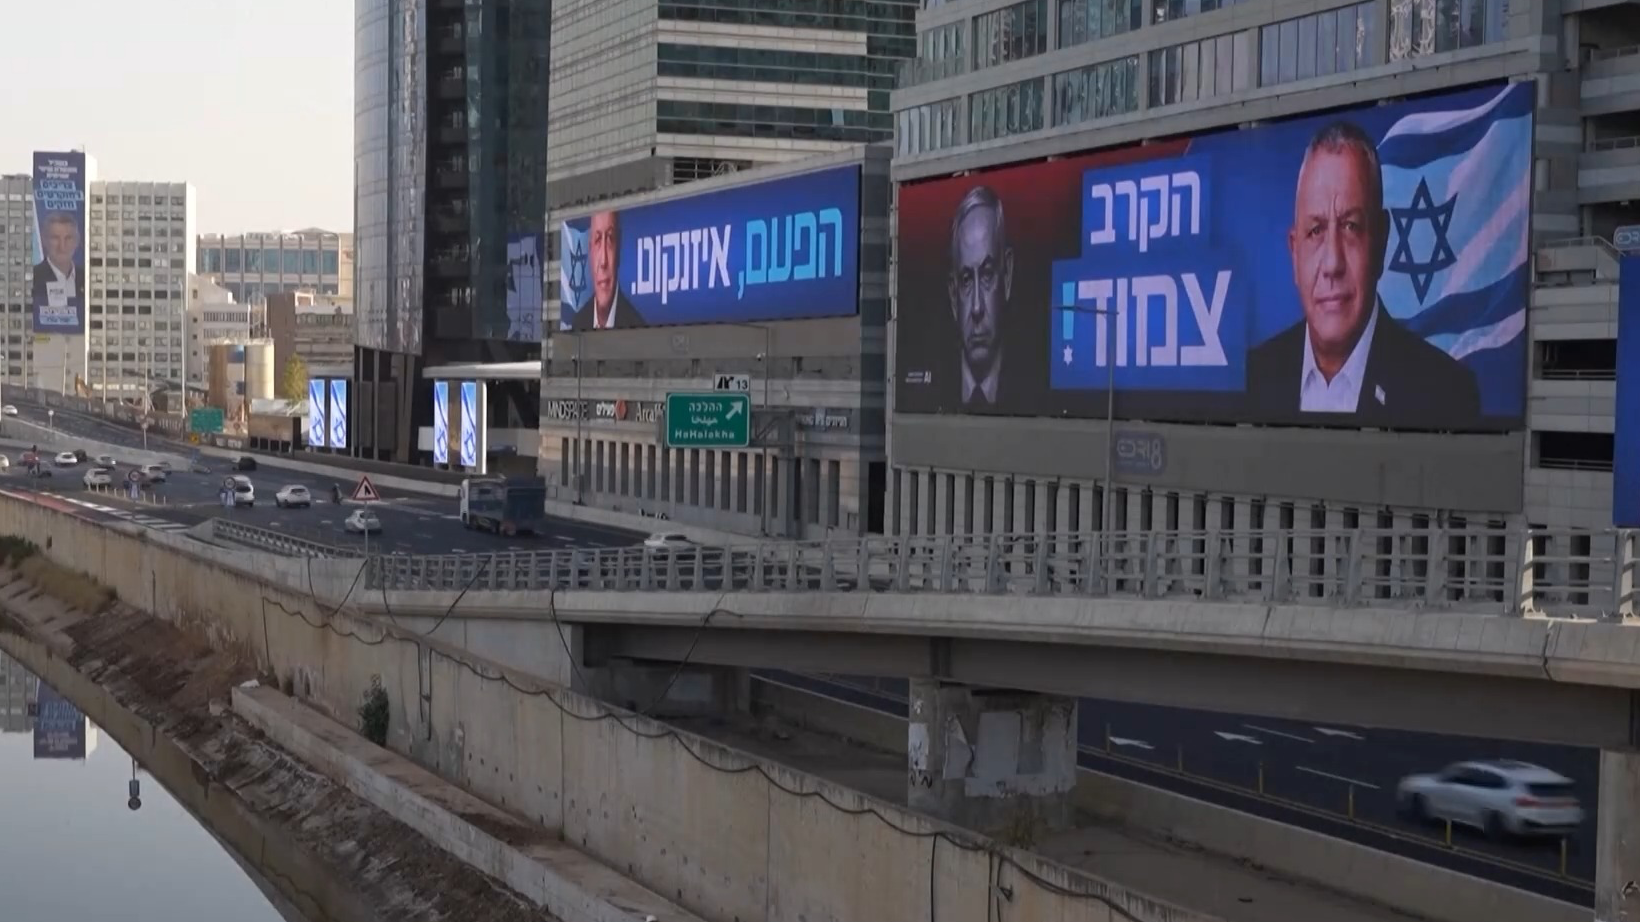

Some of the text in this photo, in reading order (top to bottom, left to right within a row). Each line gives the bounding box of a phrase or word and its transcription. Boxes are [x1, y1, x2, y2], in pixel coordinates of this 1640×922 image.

[1090, 171, 1200, 252] הקרב
[738, 207, 842, 300] הפעם,
[1062, 270, 1232, 367] צמוד!
[688, 401, 723, 412] ההלכה
[736, 380, 748, 390] 13
